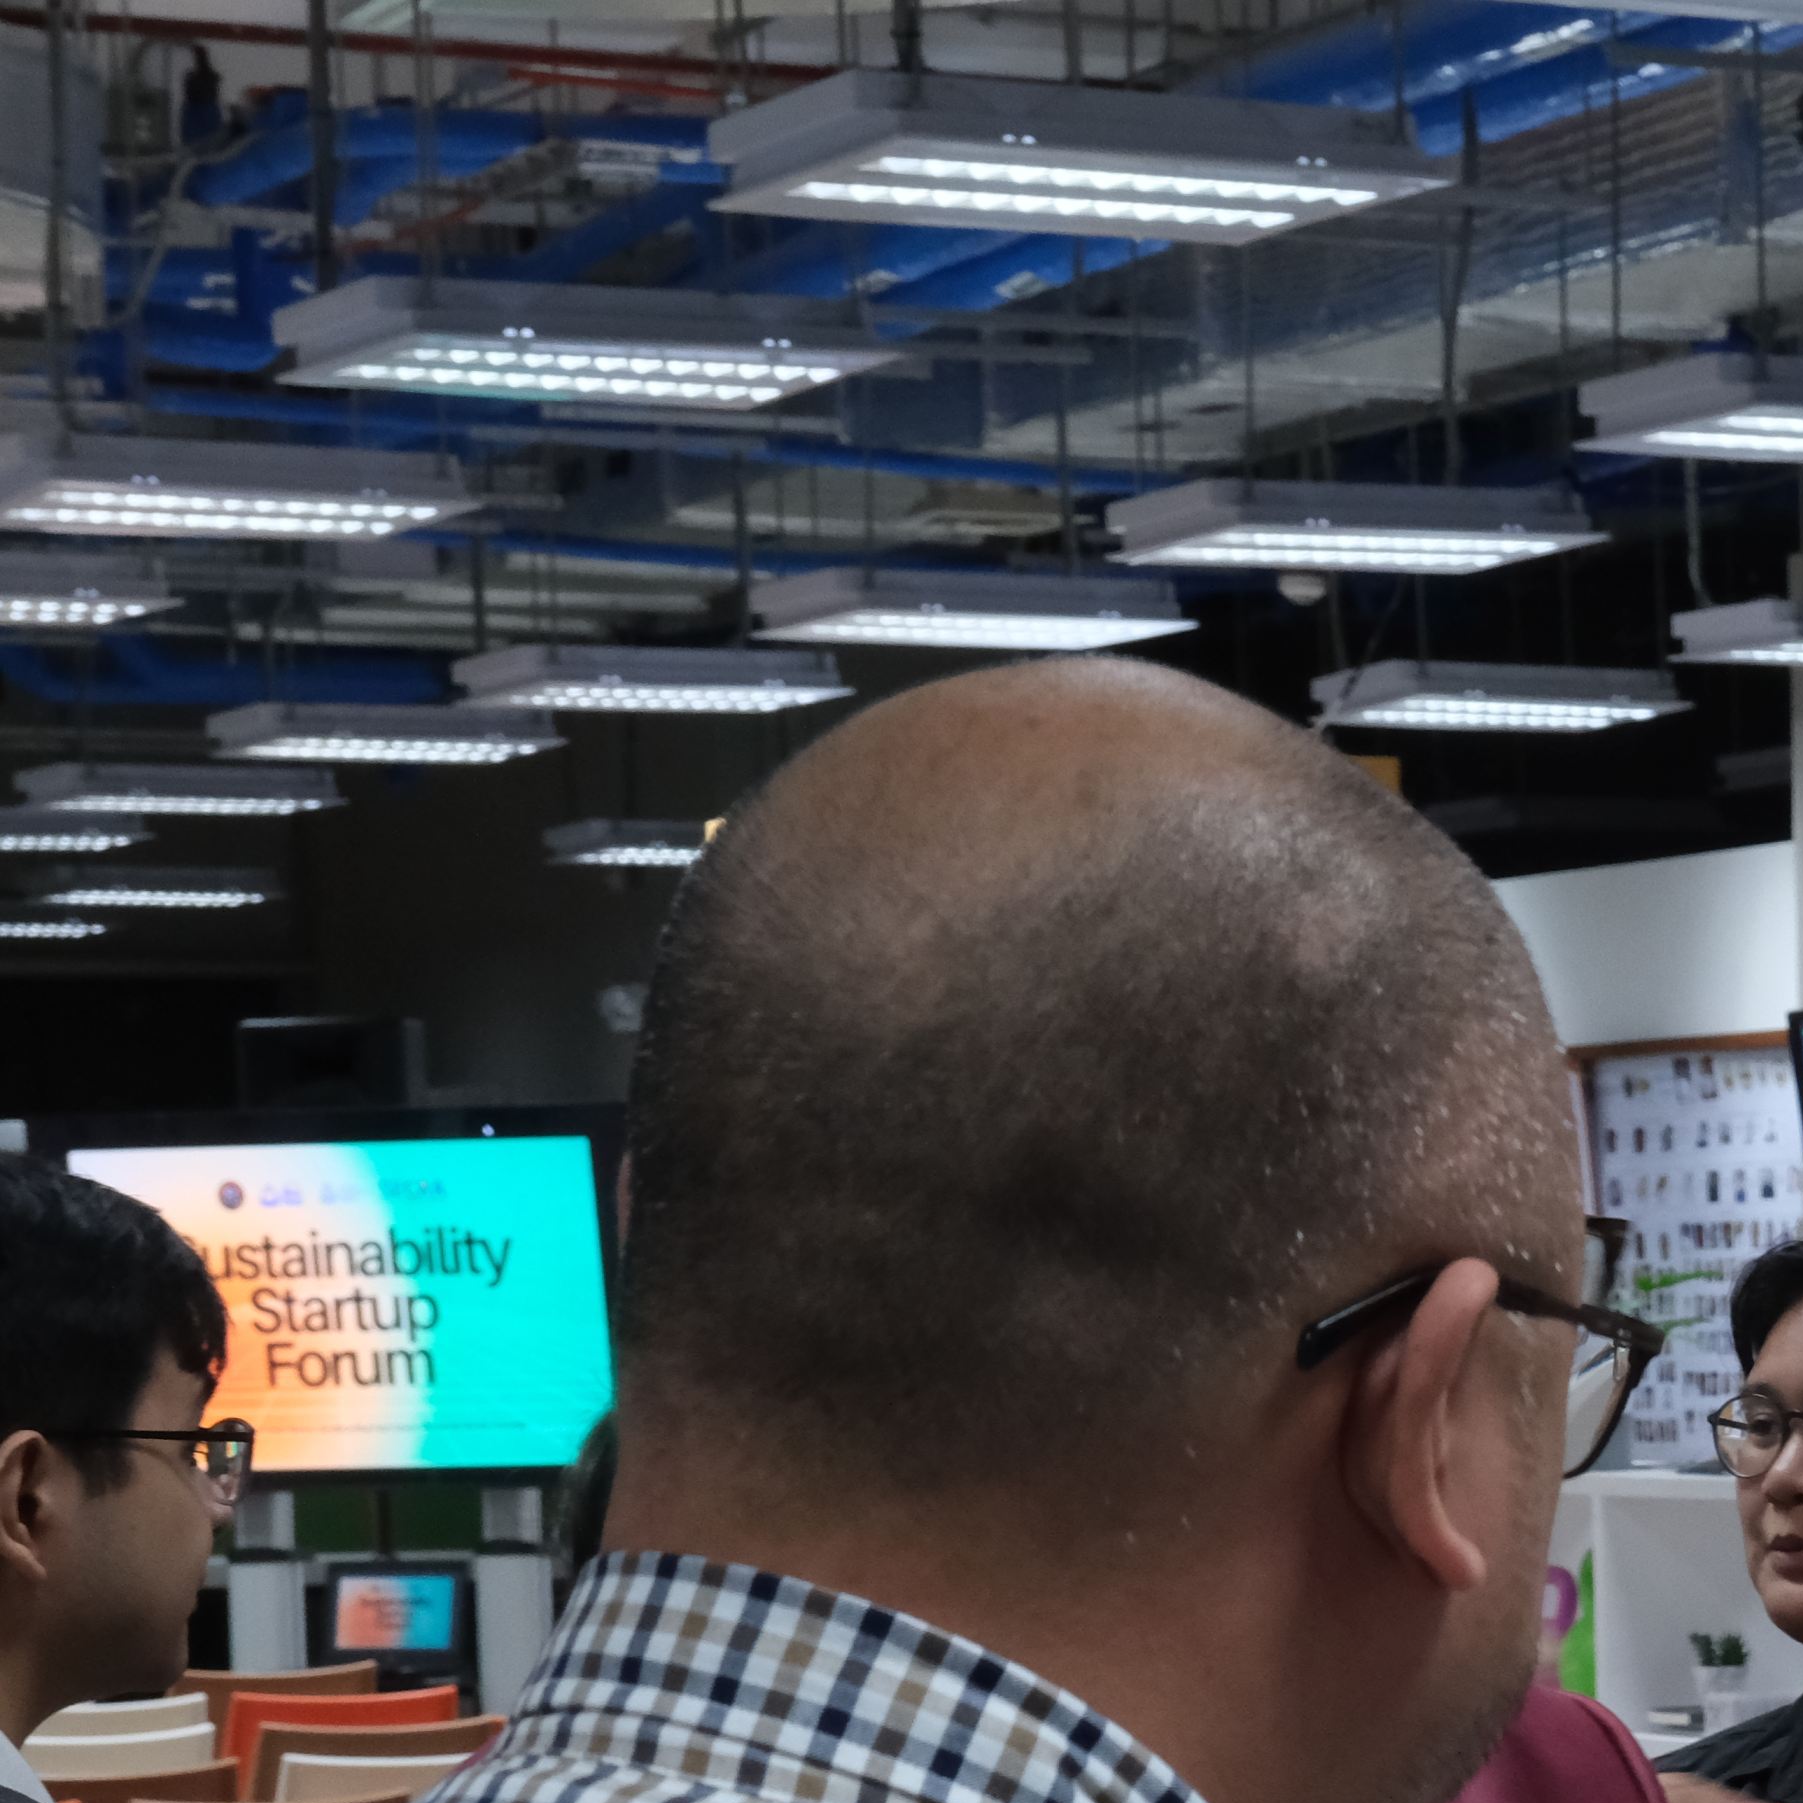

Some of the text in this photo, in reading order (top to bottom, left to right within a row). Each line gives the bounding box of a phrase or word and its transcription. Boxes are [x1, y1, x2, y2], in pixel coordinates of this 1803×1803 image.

[186, 1226, 512, 1288] ustainability
[251, 1287, 439, 1343] Startup
[267, 1342, 437, 1389] Forum
